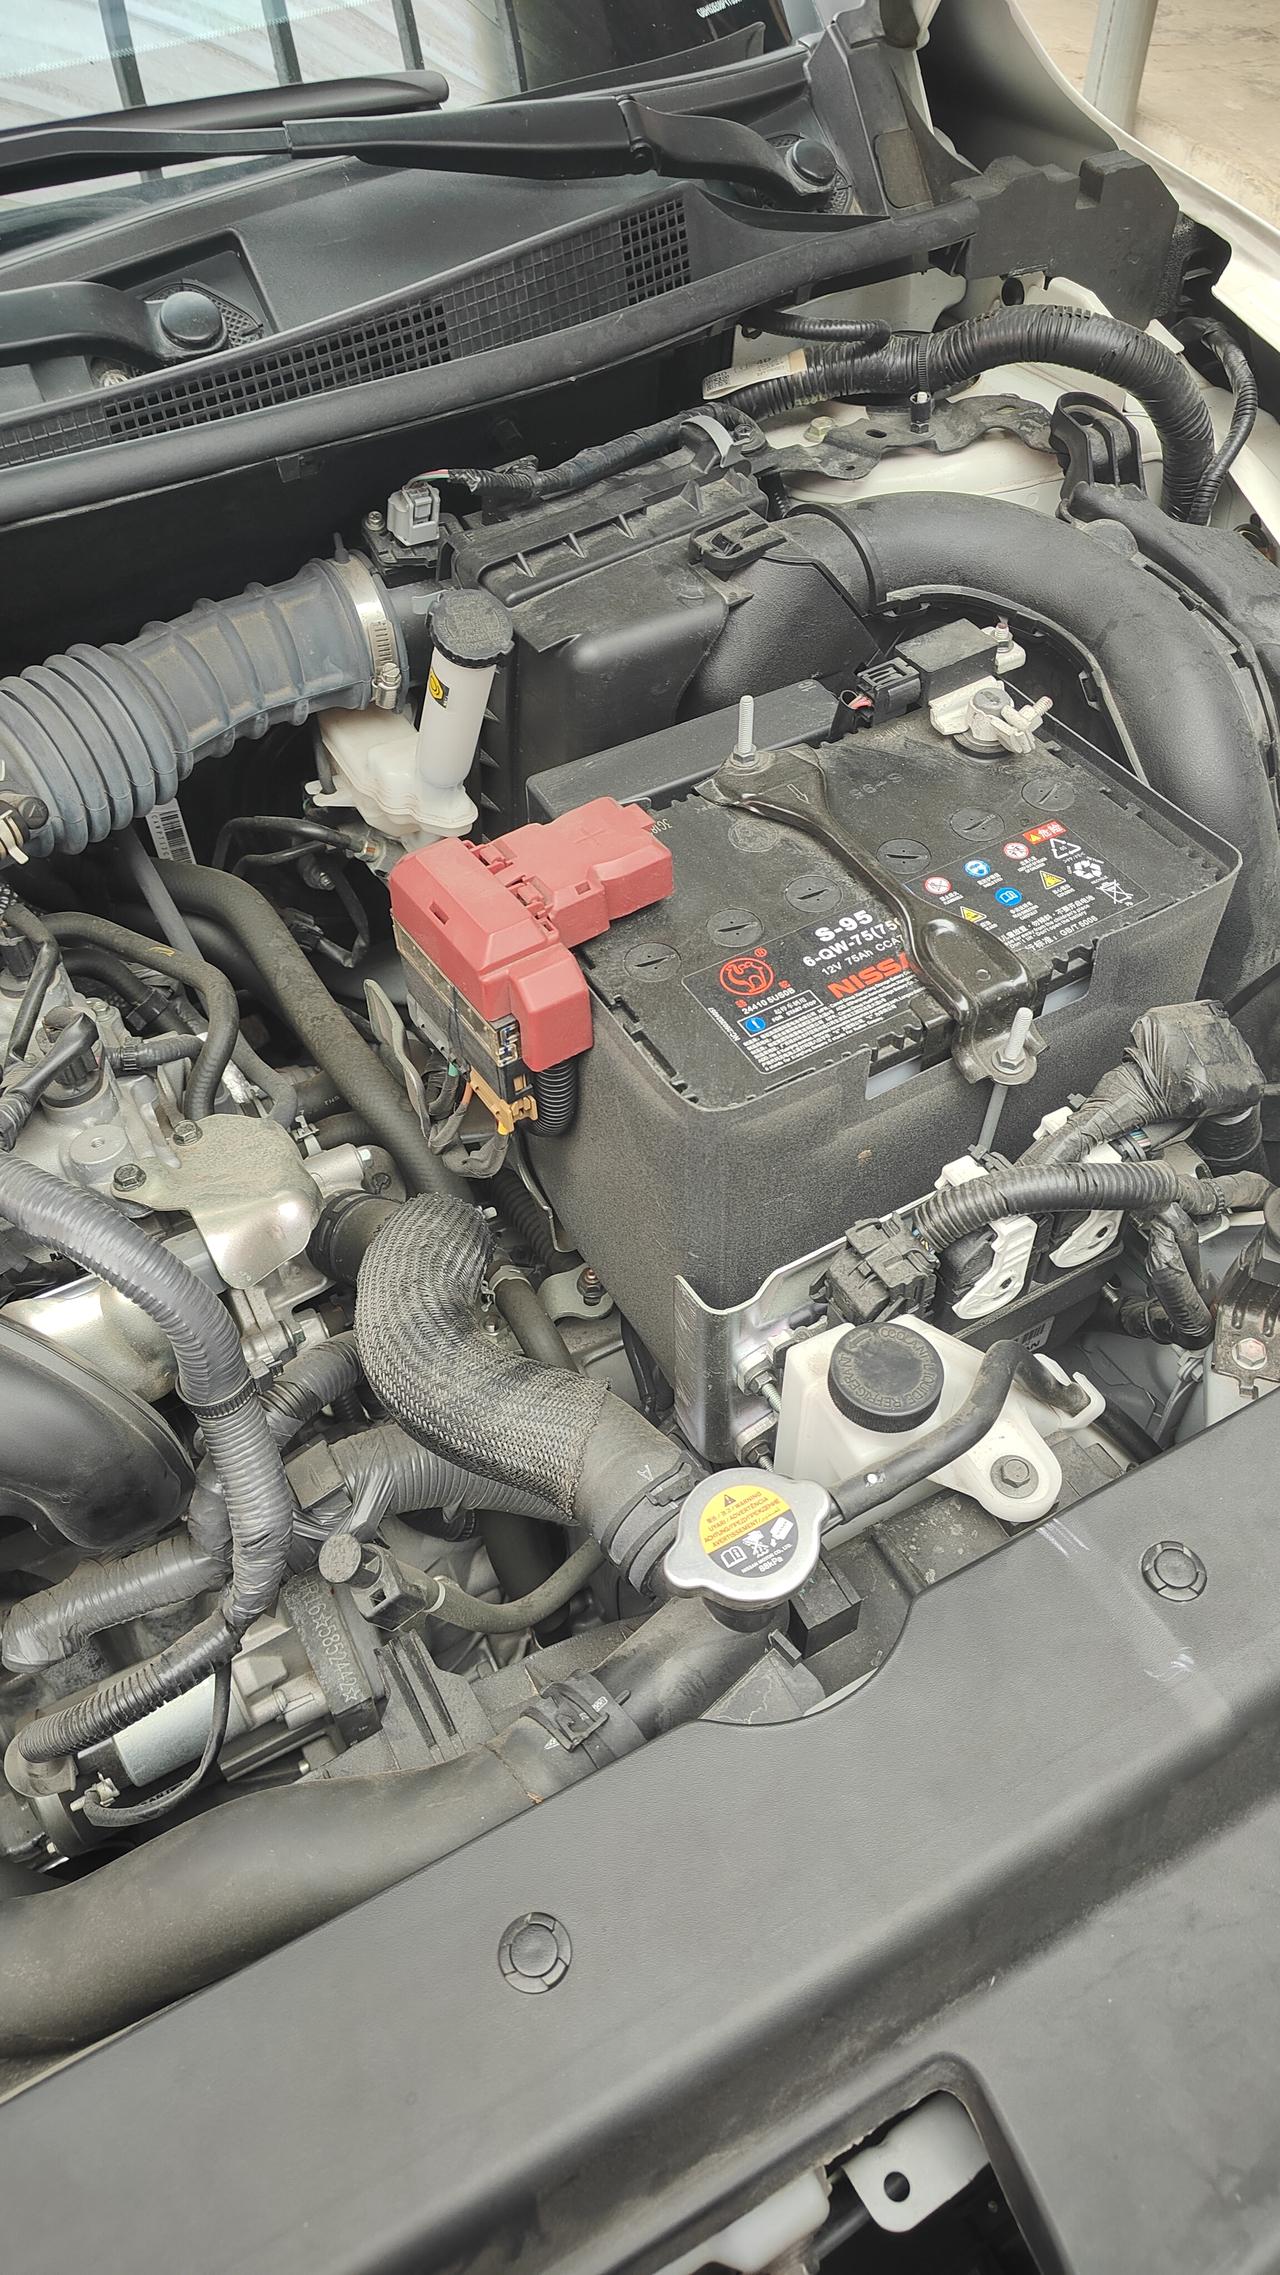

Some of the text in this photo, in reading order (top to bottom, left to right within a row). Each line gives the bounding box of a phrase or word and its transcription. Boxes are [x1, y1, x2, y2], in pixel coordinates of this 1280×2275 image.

[815, 909, 873, 942] S-95
[1078, 915, 1099, 928] 5008
[822, 961, 842, 975] 12V
[844, 949, 874, 965] 75Ah
[742, 999, 768, 1015] 24410
[771, 1014, 784, 1022] FOR
[758, 1556, 784, 1573] 88kPa
